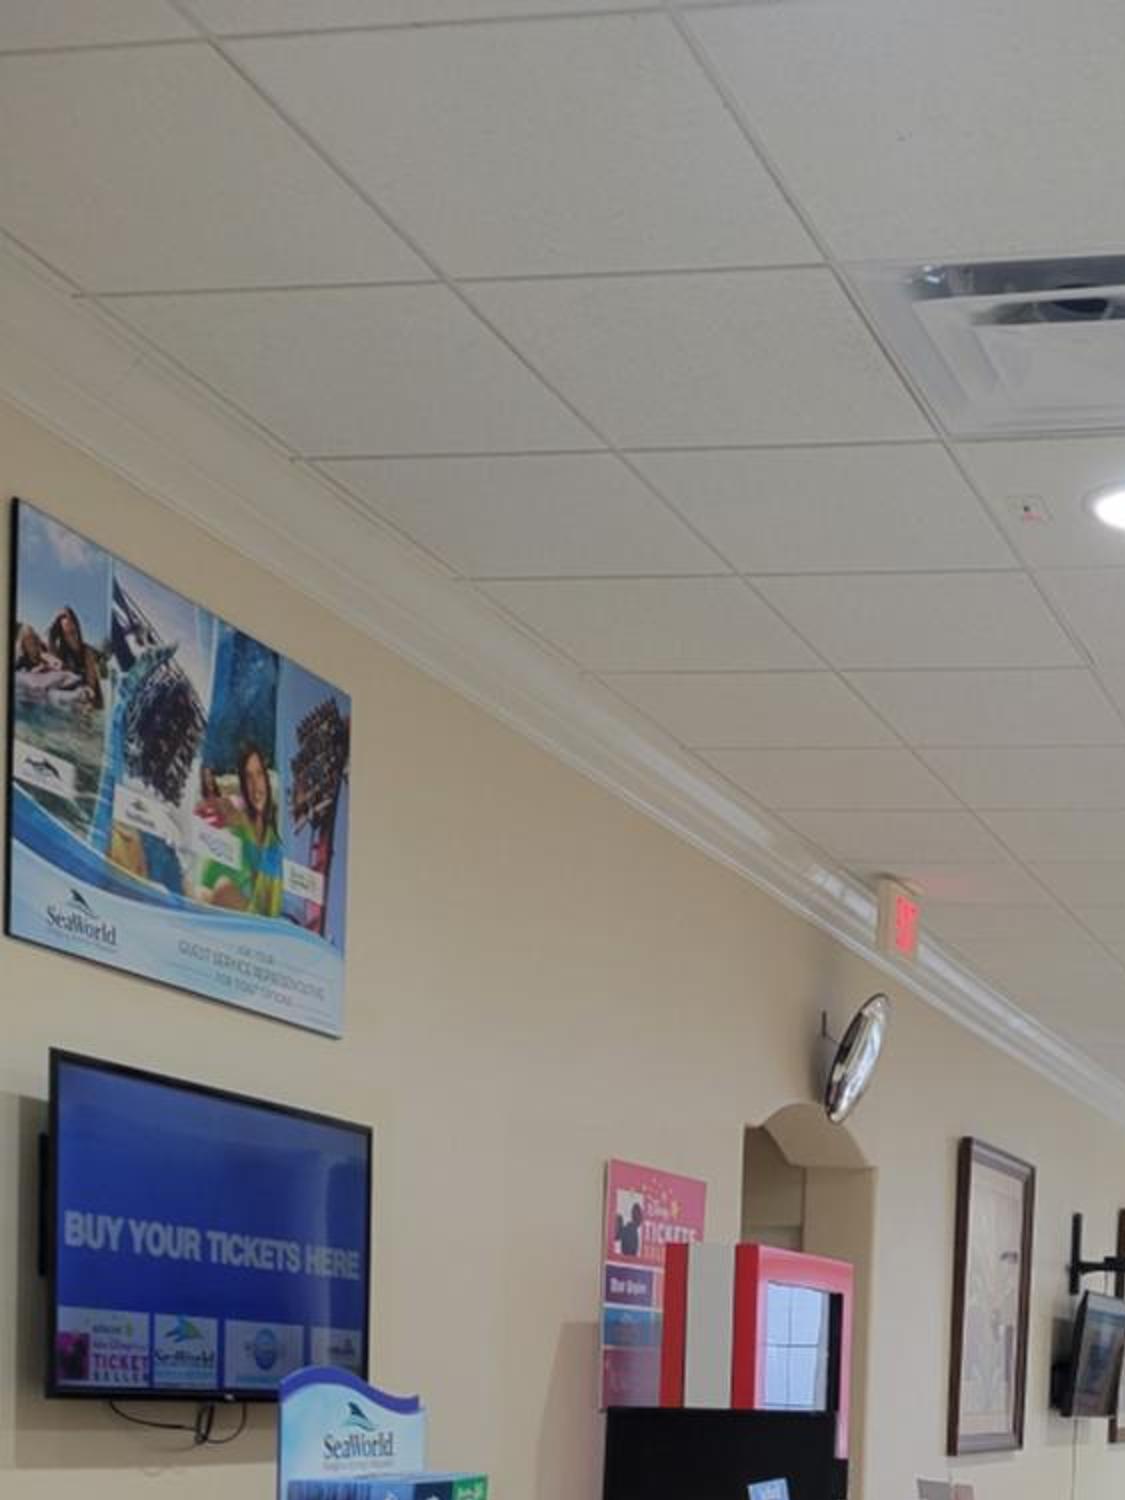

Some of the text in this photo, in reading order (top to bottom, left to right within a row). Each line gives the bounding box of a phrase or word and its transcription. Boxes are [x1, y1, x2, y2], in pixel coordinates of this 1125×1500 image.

[47, 903, 117, 946] SeaWorld
[64, 1210, 361, 1281] BUY YOUR TICKETS HERE
[643, 1219, 698, 1244] TICKETS
[322, 1431, 395, 1460] SeaWorld
